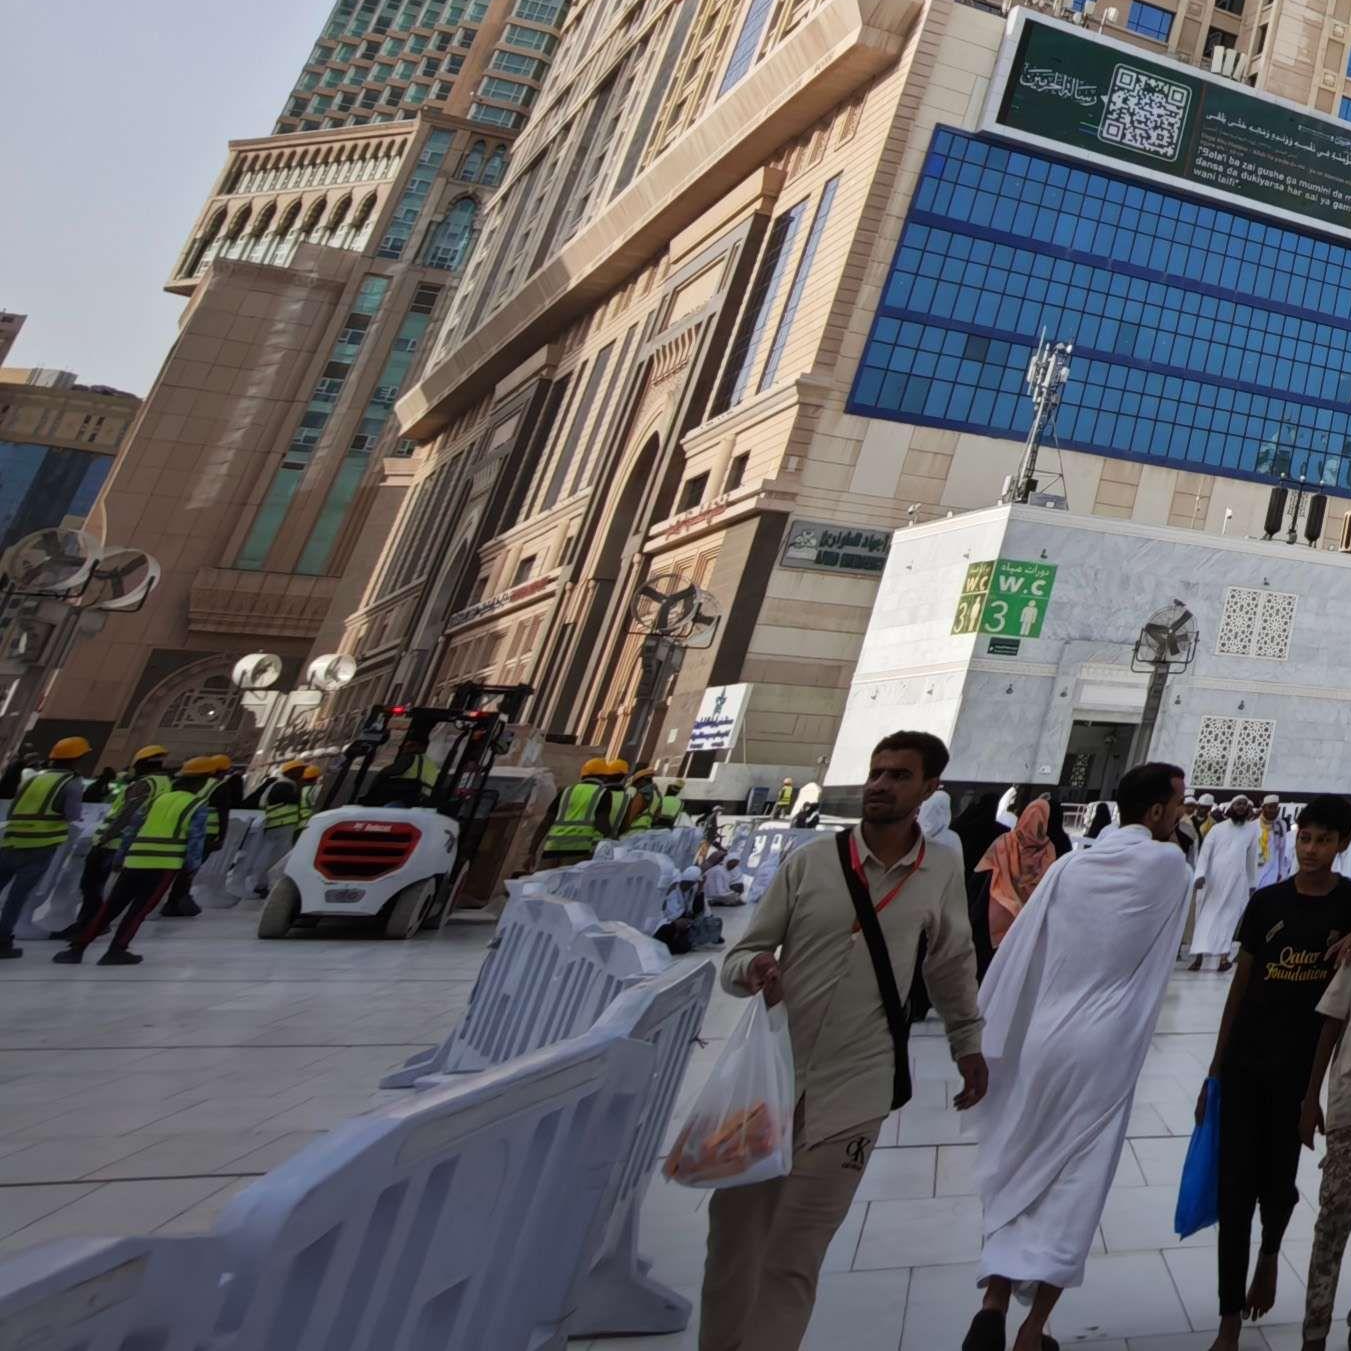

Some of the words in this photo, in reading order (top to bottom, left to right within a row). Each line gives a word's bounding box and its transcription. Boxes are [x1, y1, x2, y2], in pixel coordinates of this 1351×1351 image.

[1194, 167, 1216, 180] wani
[1227, 166, 1238, 177] da
[1321, 196, 1331, 207] ya
[1229, 155, 1240, 166] ba
[1243, 161, 1256, 170] zai
[1258, 166, 1284, 180] gushe
[1300, 179, 1331, 195] mumini
[1333, 188, 1343, 199] da
[953, 601, 969, 633] 3
[985, 599, 1009, 633] 3
[1263, 962, 1328, 981] Foundation
[1280, 946, 1322, 968] Qatar
